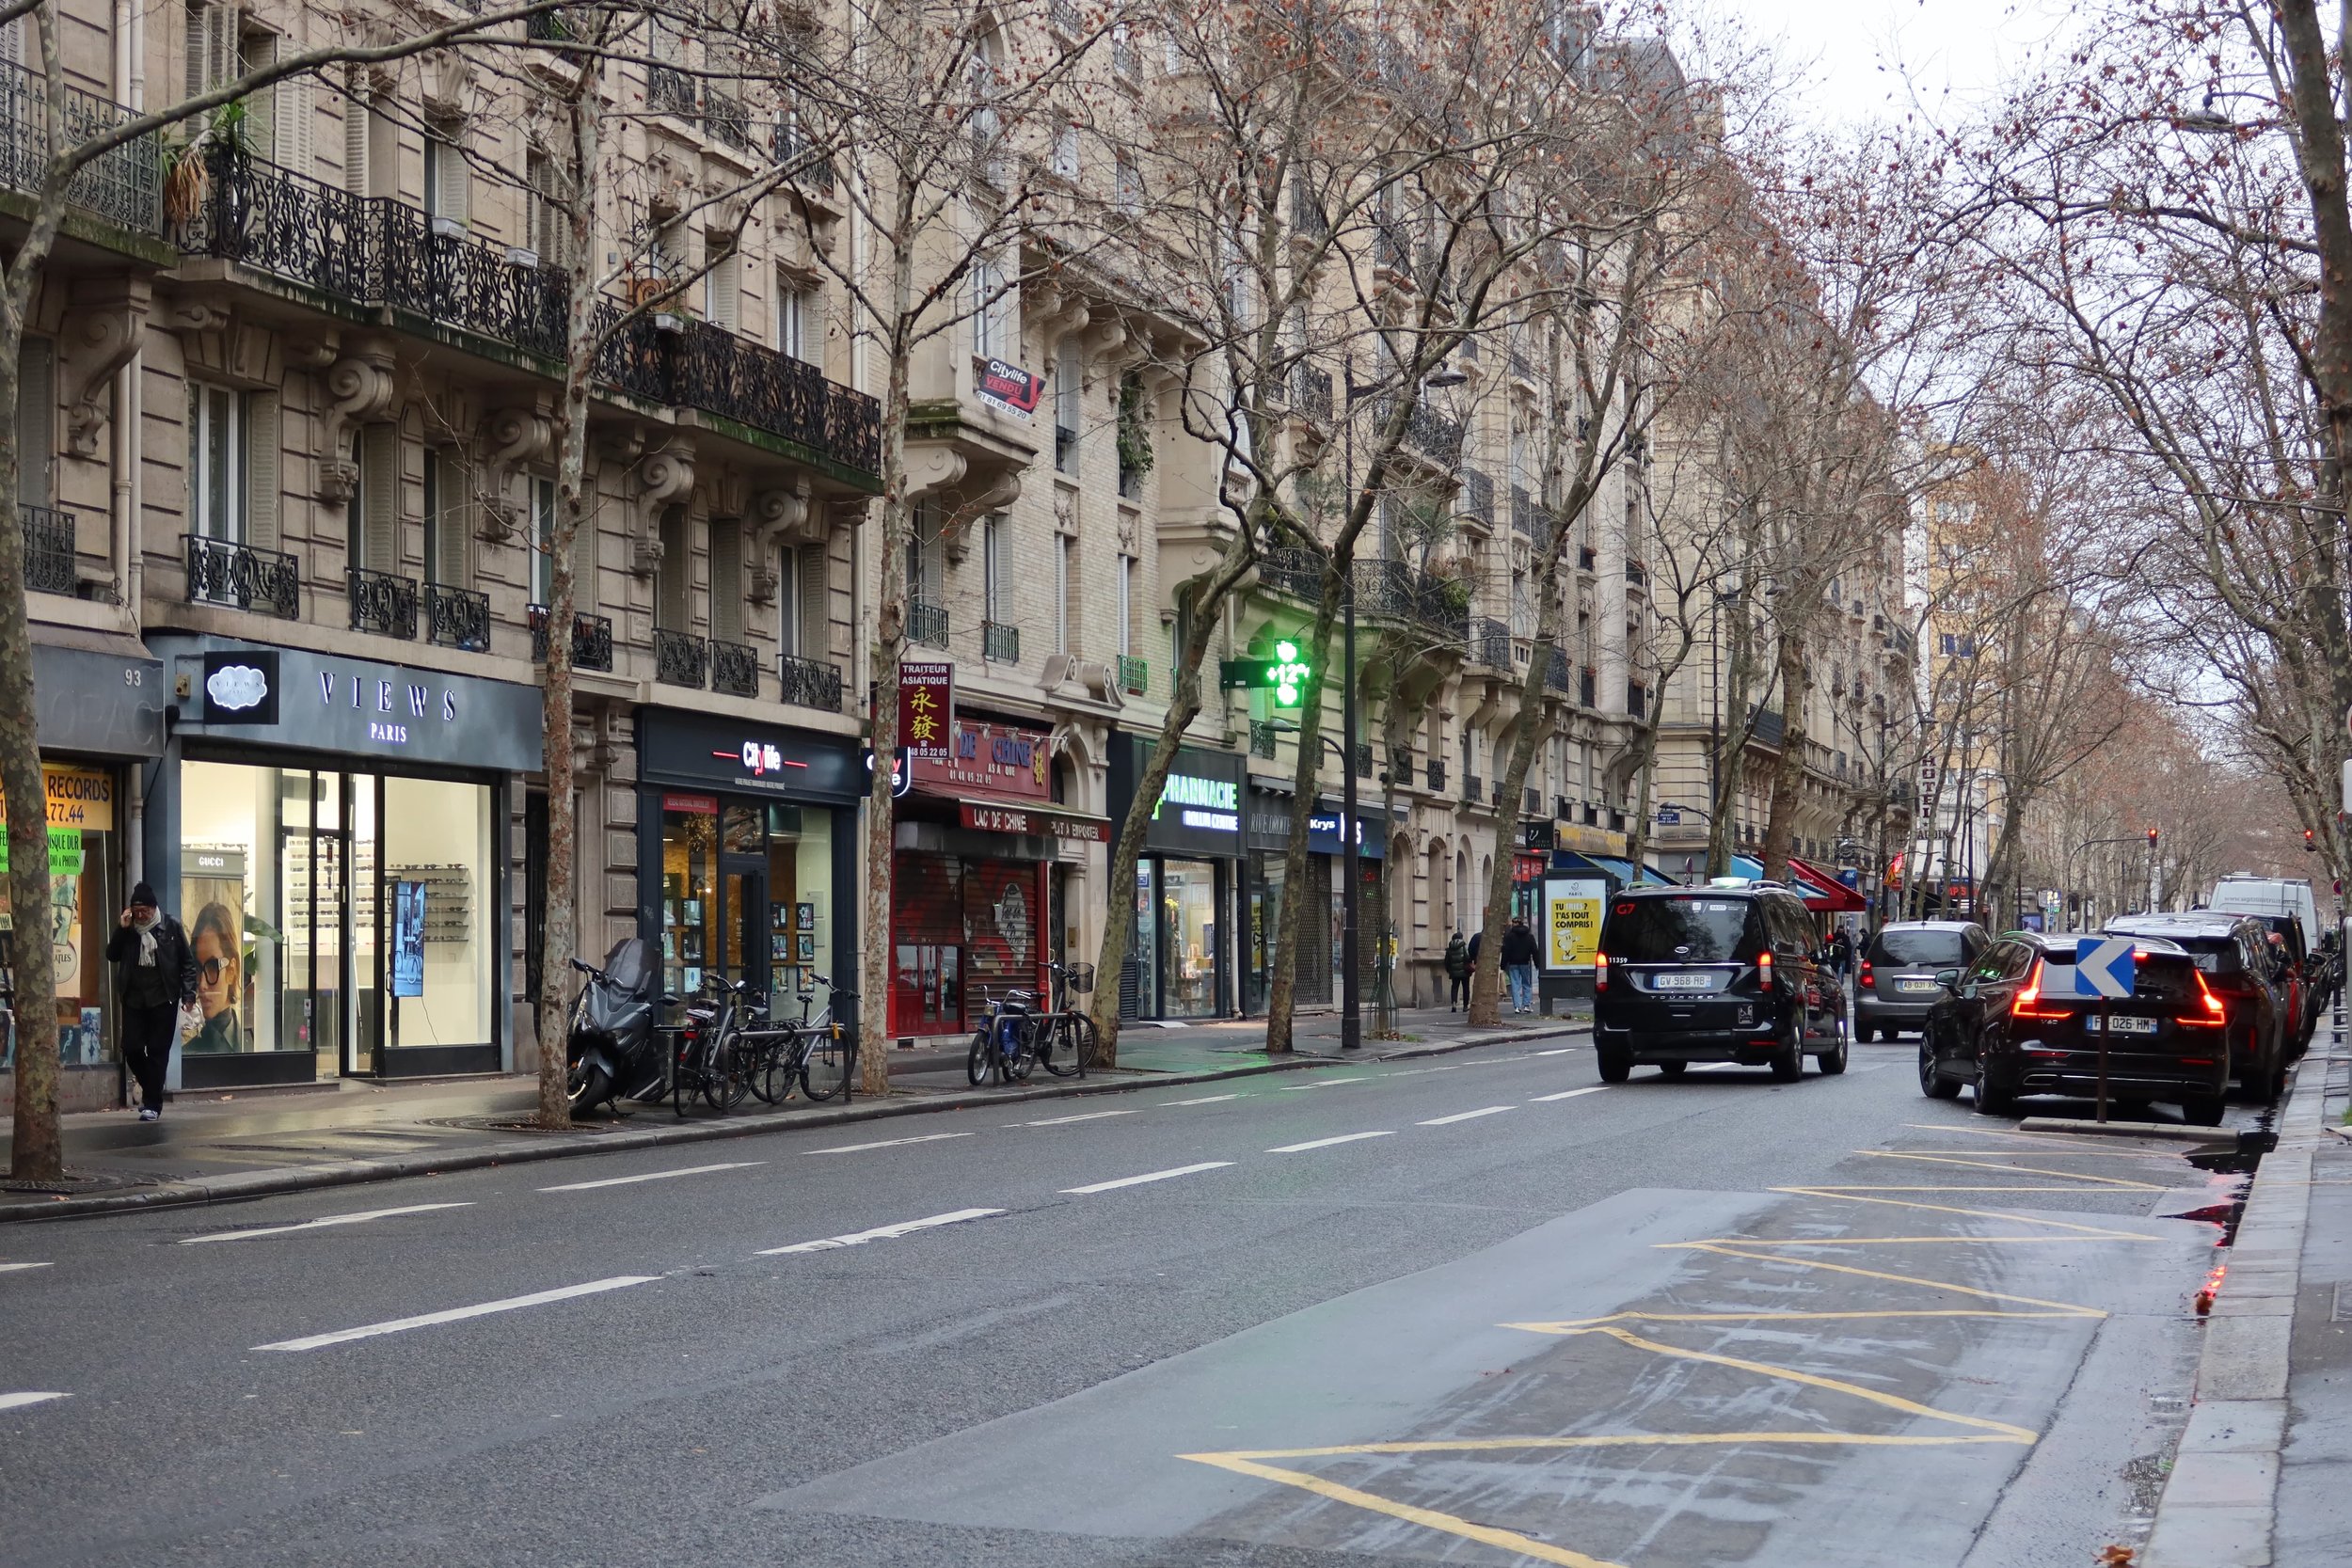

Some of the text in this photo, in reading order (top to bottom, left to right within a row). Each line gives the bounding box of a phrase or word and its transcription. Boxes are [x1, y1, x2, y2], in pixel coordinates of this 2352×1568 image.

[990, 360, 1027, 385] Citylife
[986, 376, 1024, 395] VENDU
[987, 396, 995, 405] 81
[997, 401, 1007, 410] 69
[1007, 404, 1016, 415] 55
[1017, 409, 1027, 420] 20
[902, 665, 947, 673] TRAITEUR
[124, 669, 142, 687] 93
[901, 676, 948, 685] ASIATIQUE
[319, 671, 455, 721] VIEWS
[370, 722, 407, 743] PARIS
[742, 741, 781, 776] Citylife
[919, 748, 928, 756] 05
[930, 748, 938, 756] 22
[940, 748, 947, 757] 05
[959, 733, 1031, 768] DE CHINE
[949, 769, 956, 780] 01
[976, 773, 983, 784] 22
[48, 774, 110, 801] RECORDS
[1162, 773, 1238, 811] PHARMACIE
[974, 808, 1027, 832] LAC DE CHINE
[1250, 813, 1268, 834] RIVE
[1310, 818, 1336, 832] Krys
[67, 834, 79, 850] DUR
[62, 854, 80, 867] PHOTOS
[199, 856, 224, 867] GUCCI
[1555, 911, 1570, 920] T'AS
[1616, 903, 1636, 915] G7
[54, 954, 72, 964] ATLES
[1660, 976, 1706, 986] GV-968-AB
[2094, 1017, 2150, 1031] F-026-HM
